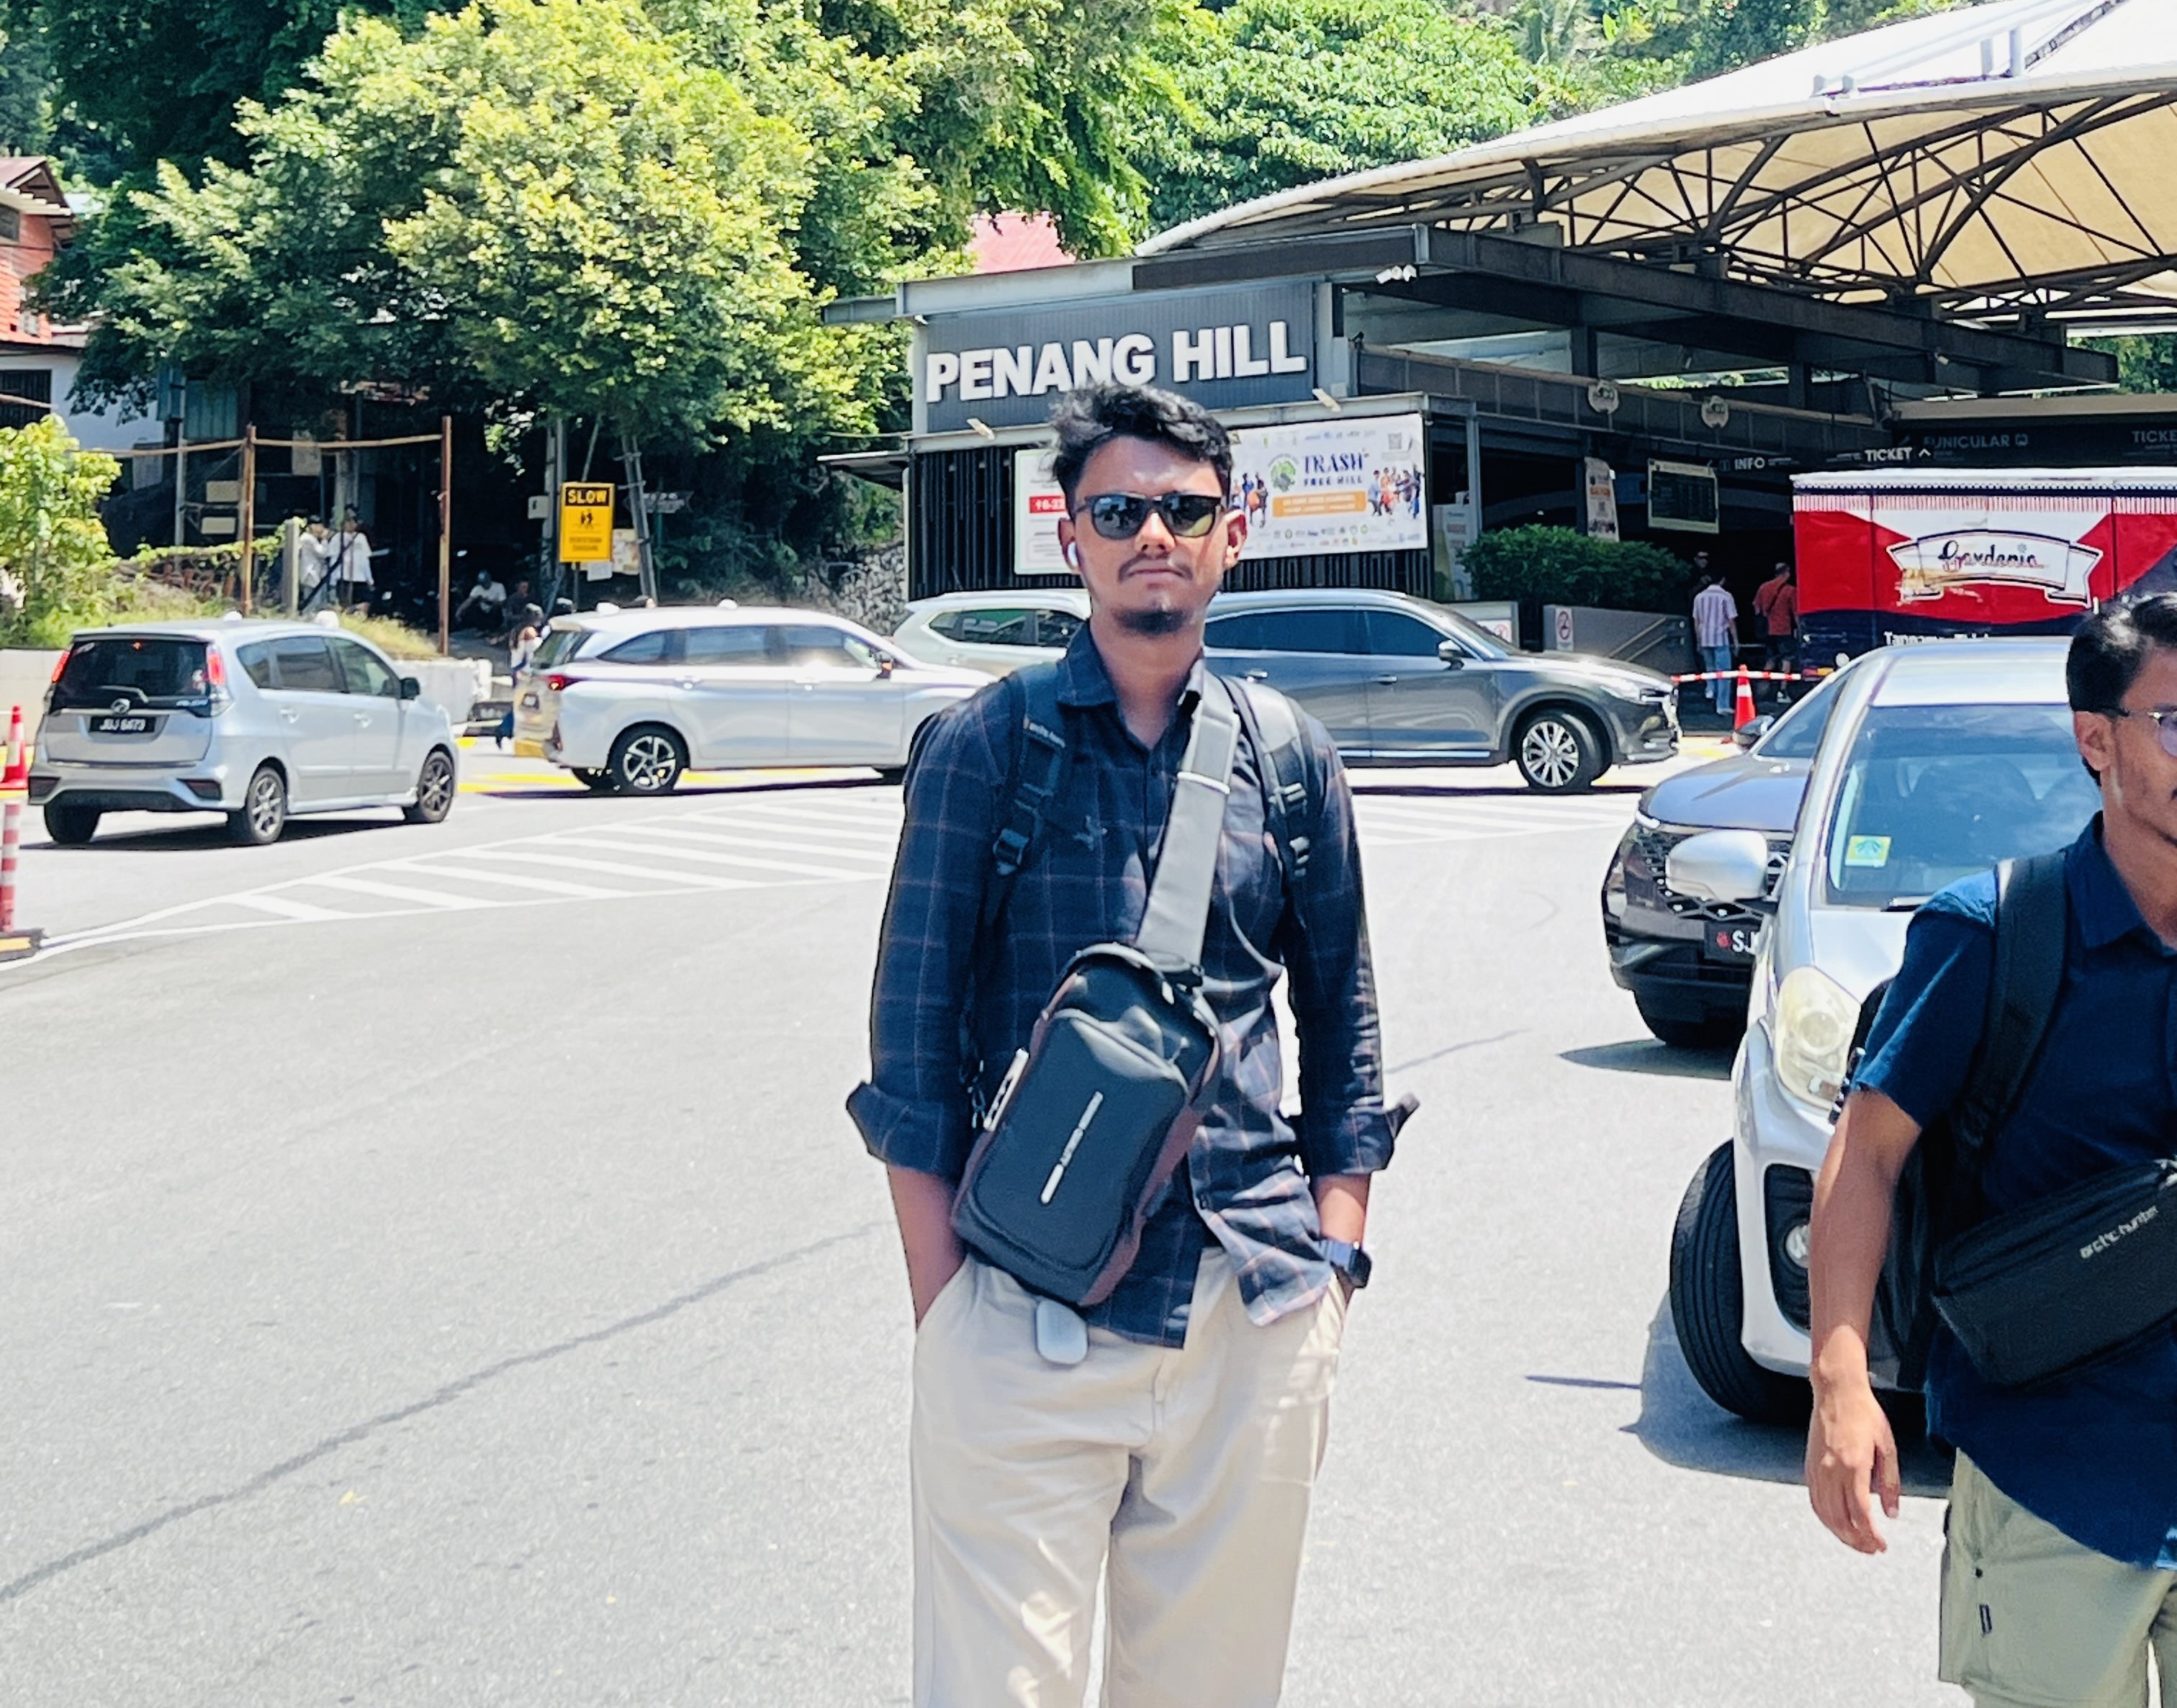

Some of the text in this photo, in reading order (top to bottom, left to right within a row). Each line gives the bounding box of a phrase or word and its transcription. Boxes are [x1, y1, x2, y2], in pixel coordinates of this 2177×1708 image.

[925, 320, 1307, 403] PENANG HILL
[1865, 447, 1913, 462] TICKET
[1302, 452, 1364, 474] TRASH
[1734, 456, 1765, 470] INFO
[567, 489, 608, 504] SLOW
